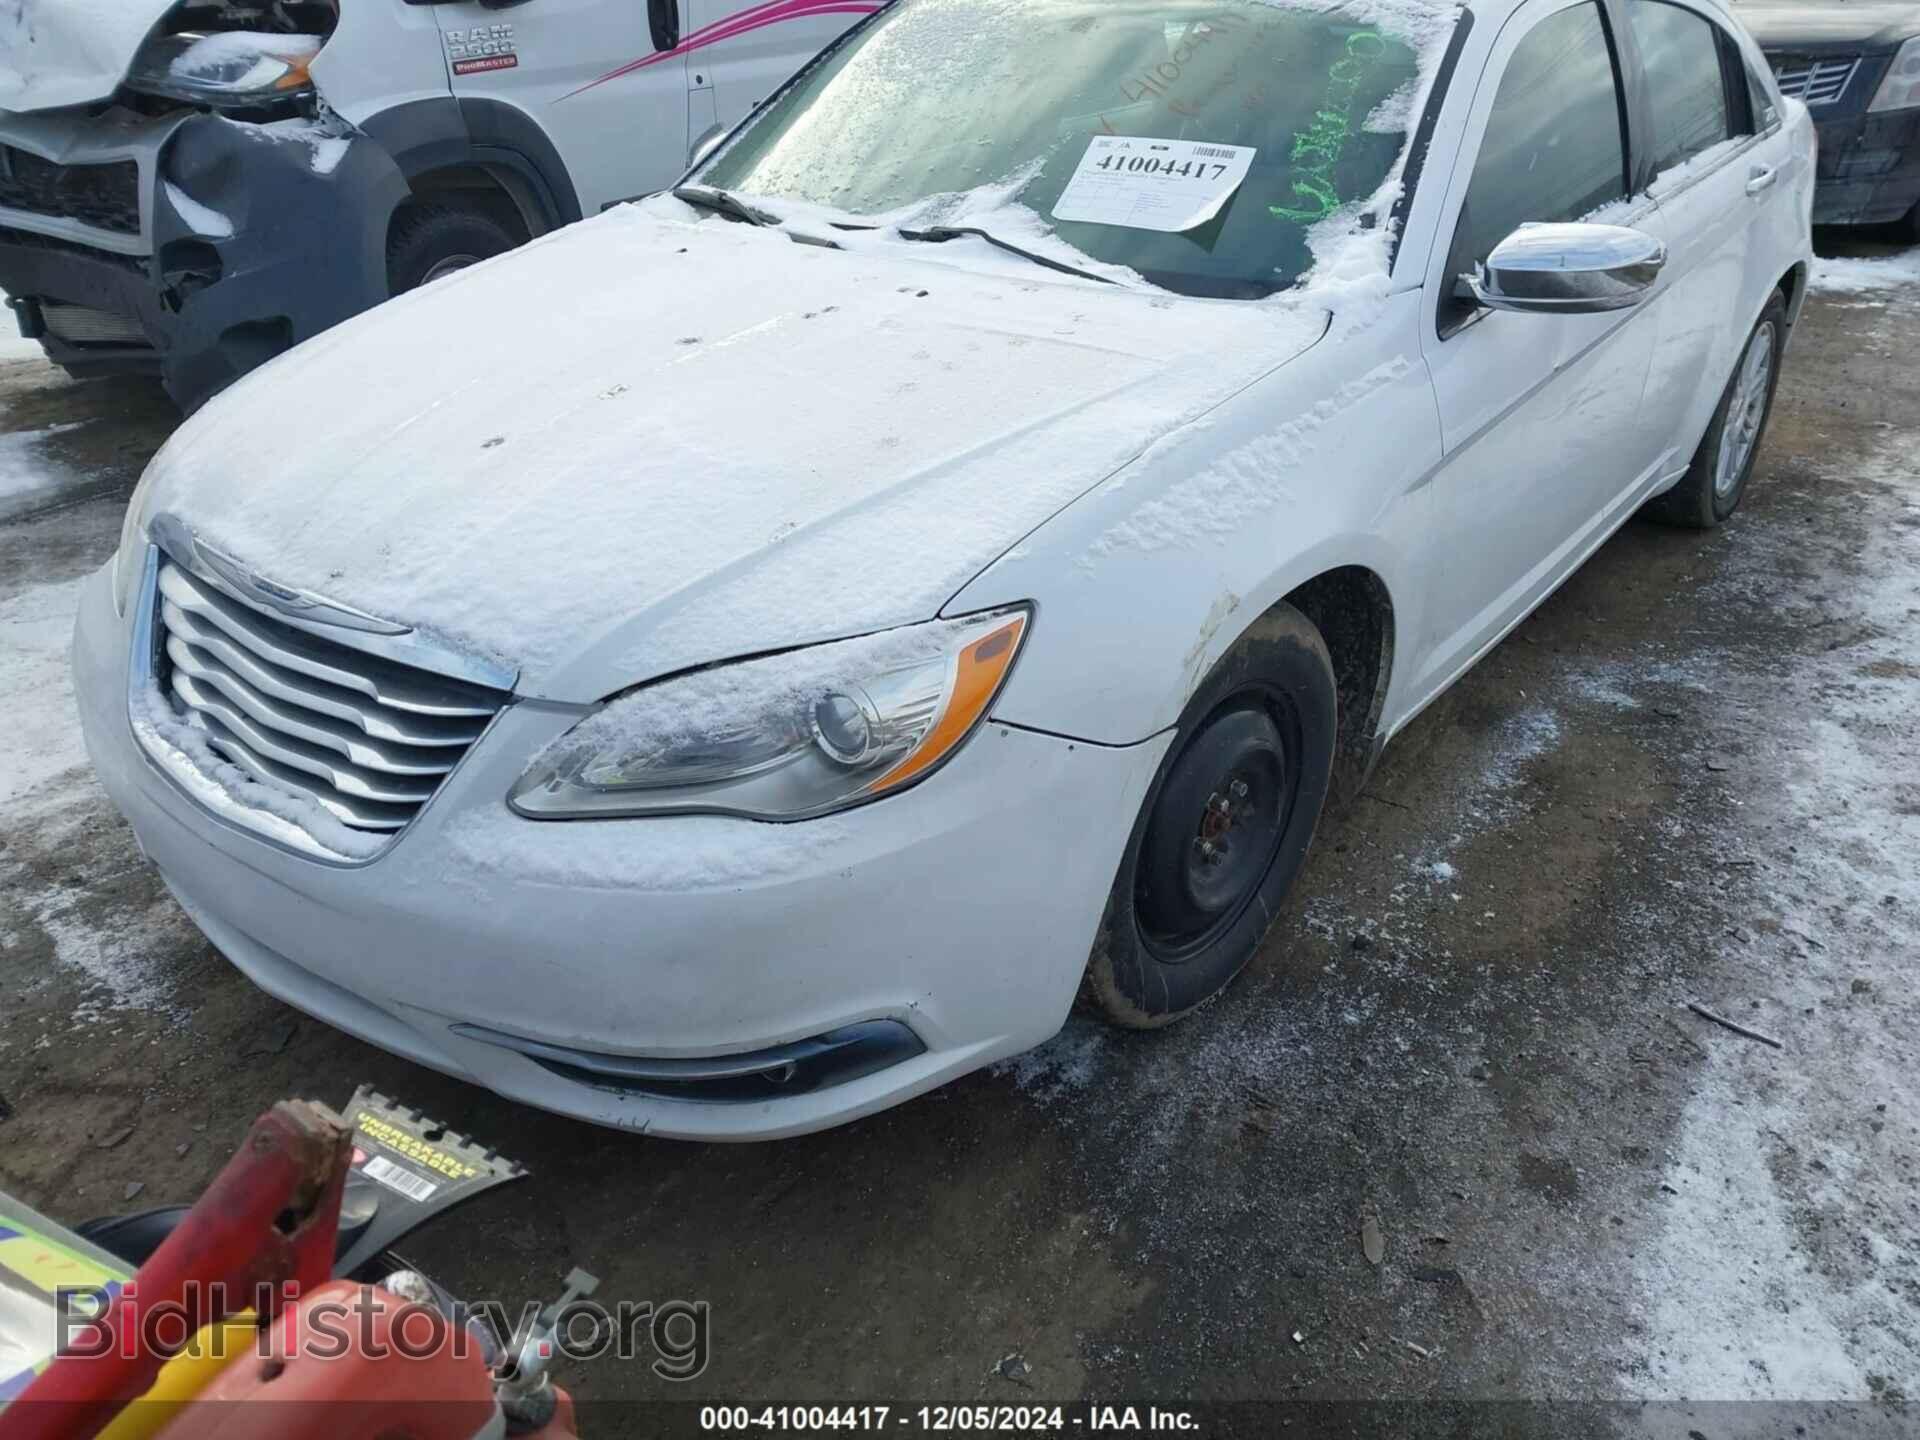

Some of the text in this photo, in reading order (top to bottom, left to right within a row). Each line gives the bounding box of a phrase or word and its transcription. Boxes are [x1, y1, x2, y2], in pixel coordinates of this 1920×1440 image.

[447, 24, 513, 45] RAM
[449, 41, 516, 58] 2500
[1096, 154, 1227, 180] 41004417
[358, 1111, 477, 1178] UNBREAKABLE
[359, 1122, 463, 1180] INCASSABLE
